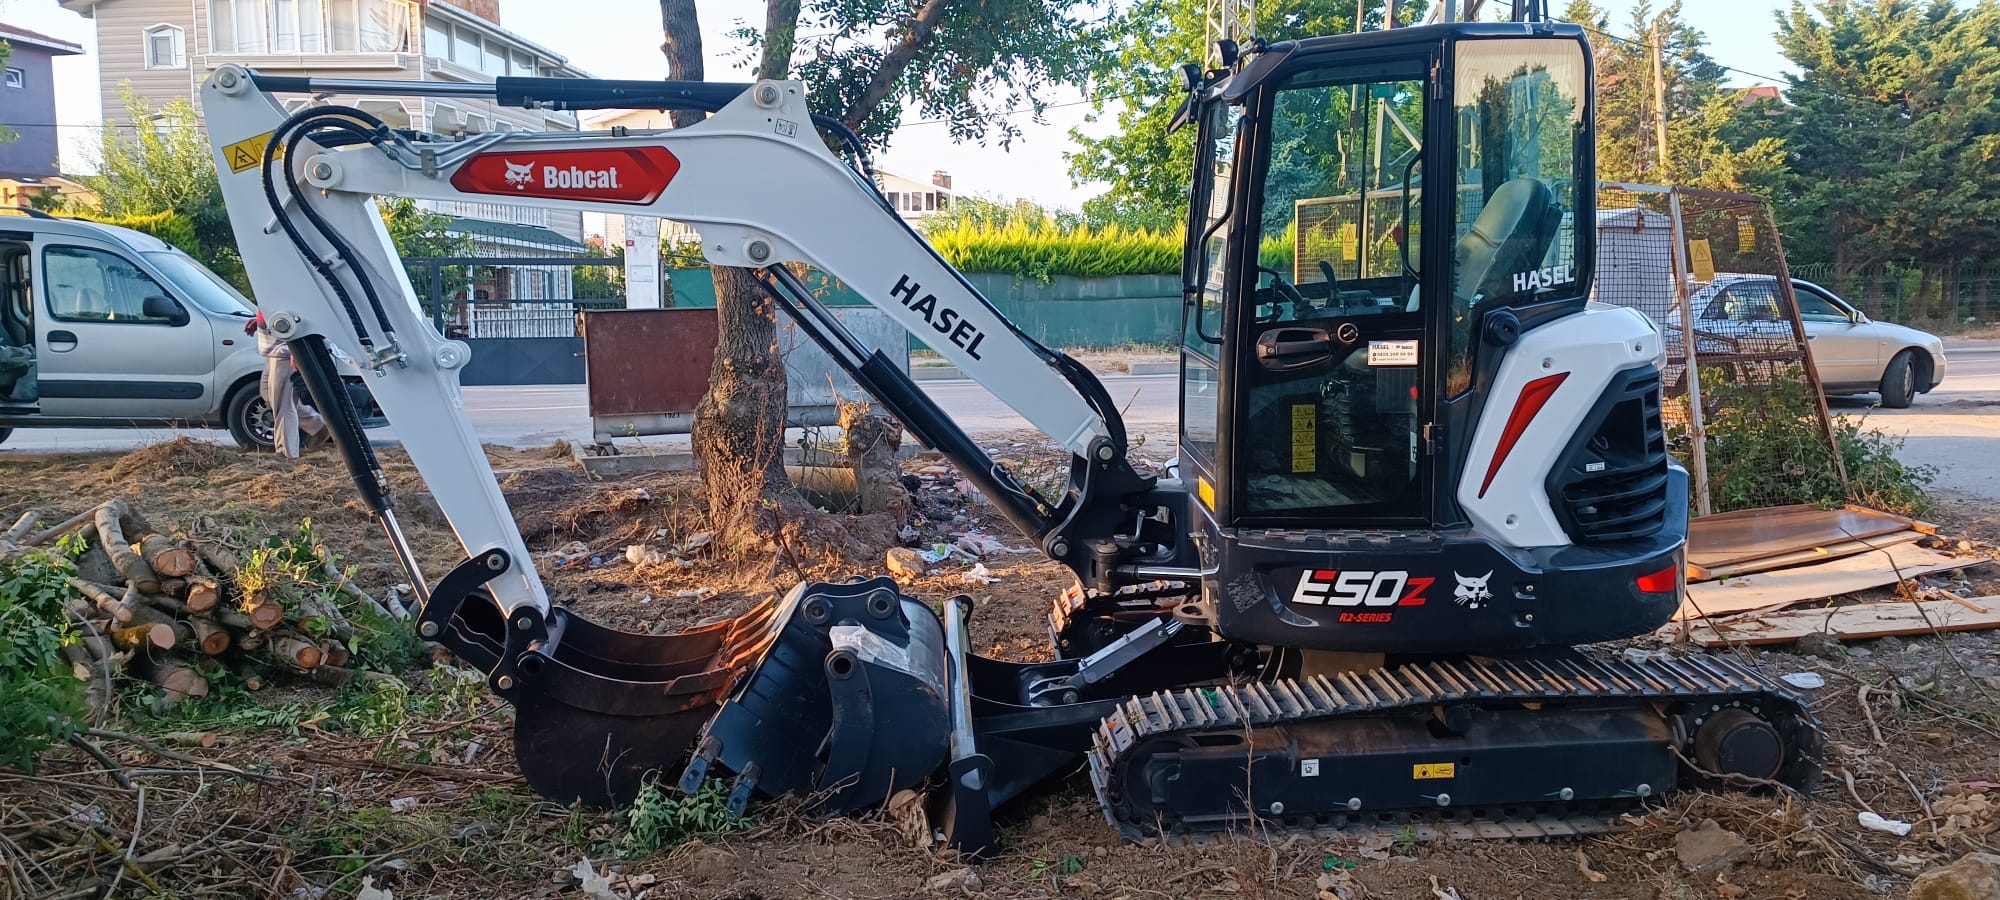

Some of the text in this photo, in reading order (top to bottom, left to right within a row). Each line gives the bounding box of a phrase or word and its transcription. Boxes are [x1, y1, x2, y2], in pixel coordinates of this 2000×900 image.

[543, 165, 618, 189] Bobcat
[1513, 264, 1575, 293] HASEL
[889, 273, 985, 361] HASEL
[1338, 612, 1393, 623] R2-SERIES
